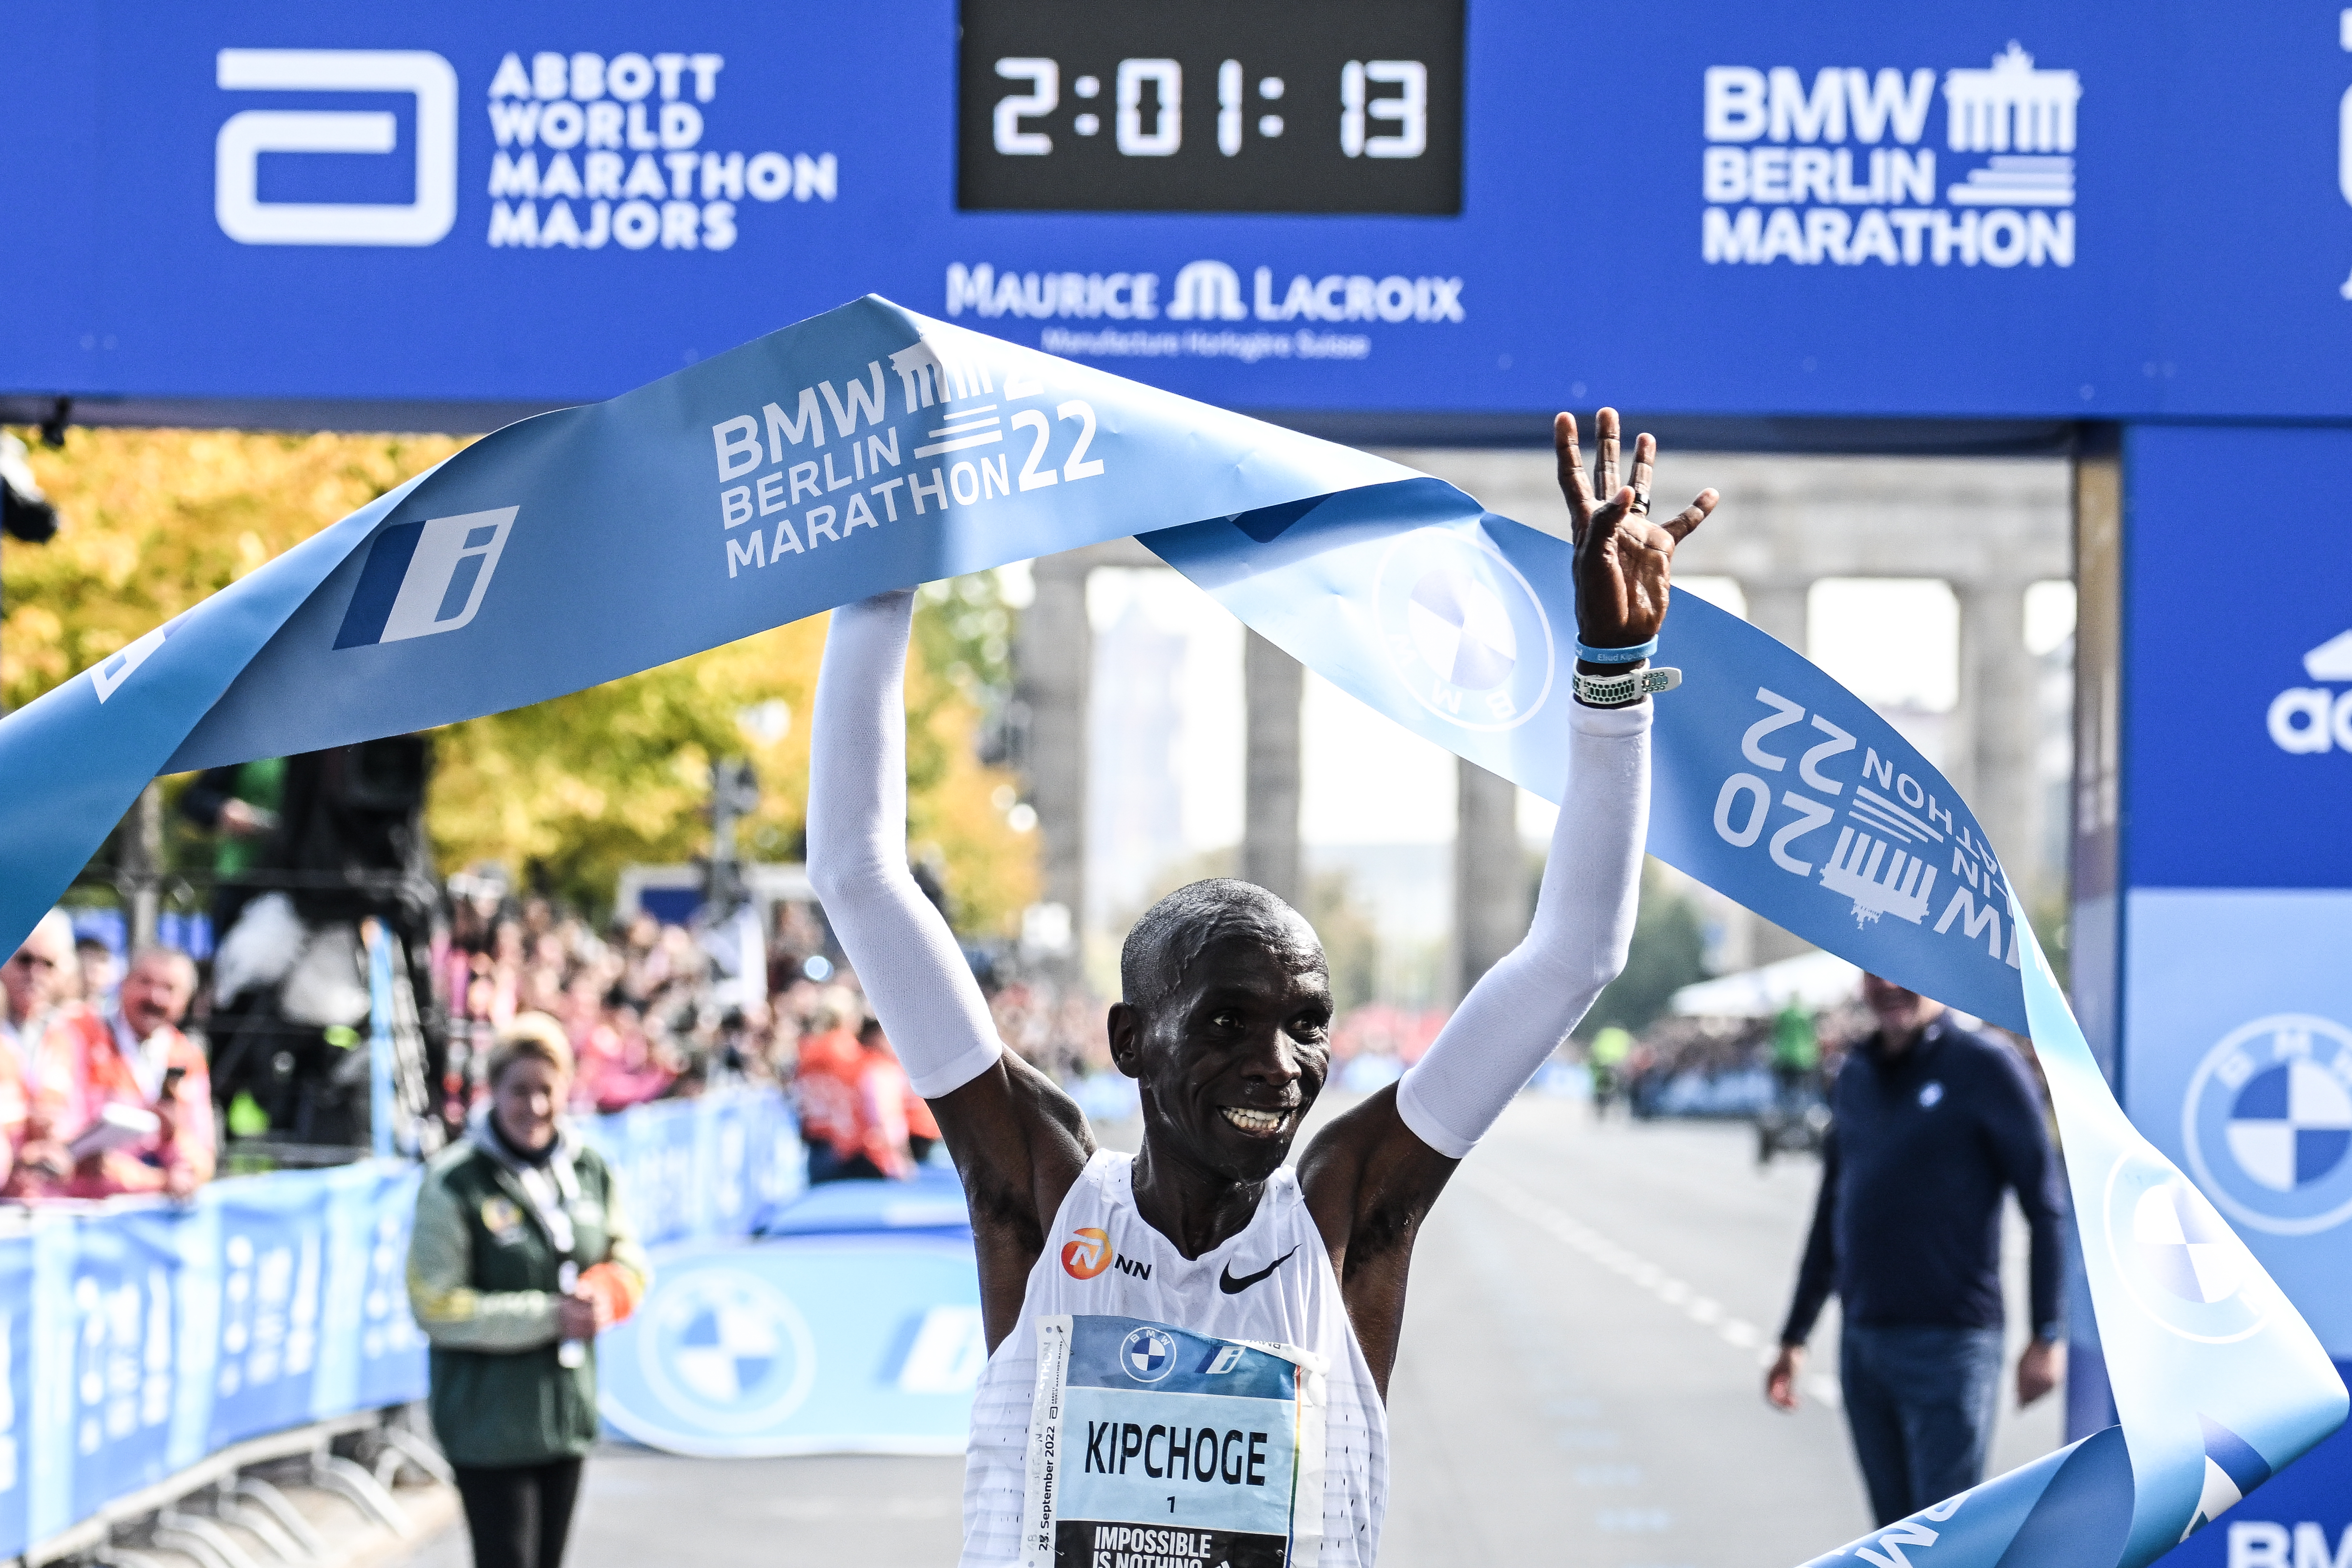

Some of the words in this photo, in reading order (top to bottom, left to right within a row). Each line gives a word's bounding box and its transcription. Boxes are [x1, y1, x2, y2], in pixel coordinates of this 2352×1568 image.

[488, 51, 723, 101] ABBOTT
[1704, 66, 1936, 142] BMW
[489, 102, 704, 150] WORLD
[488, 151, 838, 203] MARATHON
[1703, 147, 1936, 204] BERLIN
[488, 201, 737, 251] MAJORS
[1702, 207, 2076, 267] MARATHON
[945, 261, 1159, 319] MAURICE
[1254, 266, 1465, 323] LACROIX
[712, 360, 886, 483] BMW
[1011, 399, 1105, 493] 22
[720, 426, 901, 531] BERLIN
[726, 453, 1010, 579] MARATHON
[1740, 686, 1858, 795] 22
[1713, 772, 1836, 877] 20
[1114, 1253, 1152, 1281] NN
[1130, 1330, 1171, 1346] BMW
[1044, 1426, 1055, 1458] 2022
[1085, 1420, 1267, 1486] KIPCHOGE
[1040, 1460, 1053, 1529] September
[1167, 1495, 1175, 1513] 1
[1092, 1551, 1111, 1568] IS
[1094, 1526, 1212, 1558] IMPOSSIBLE
